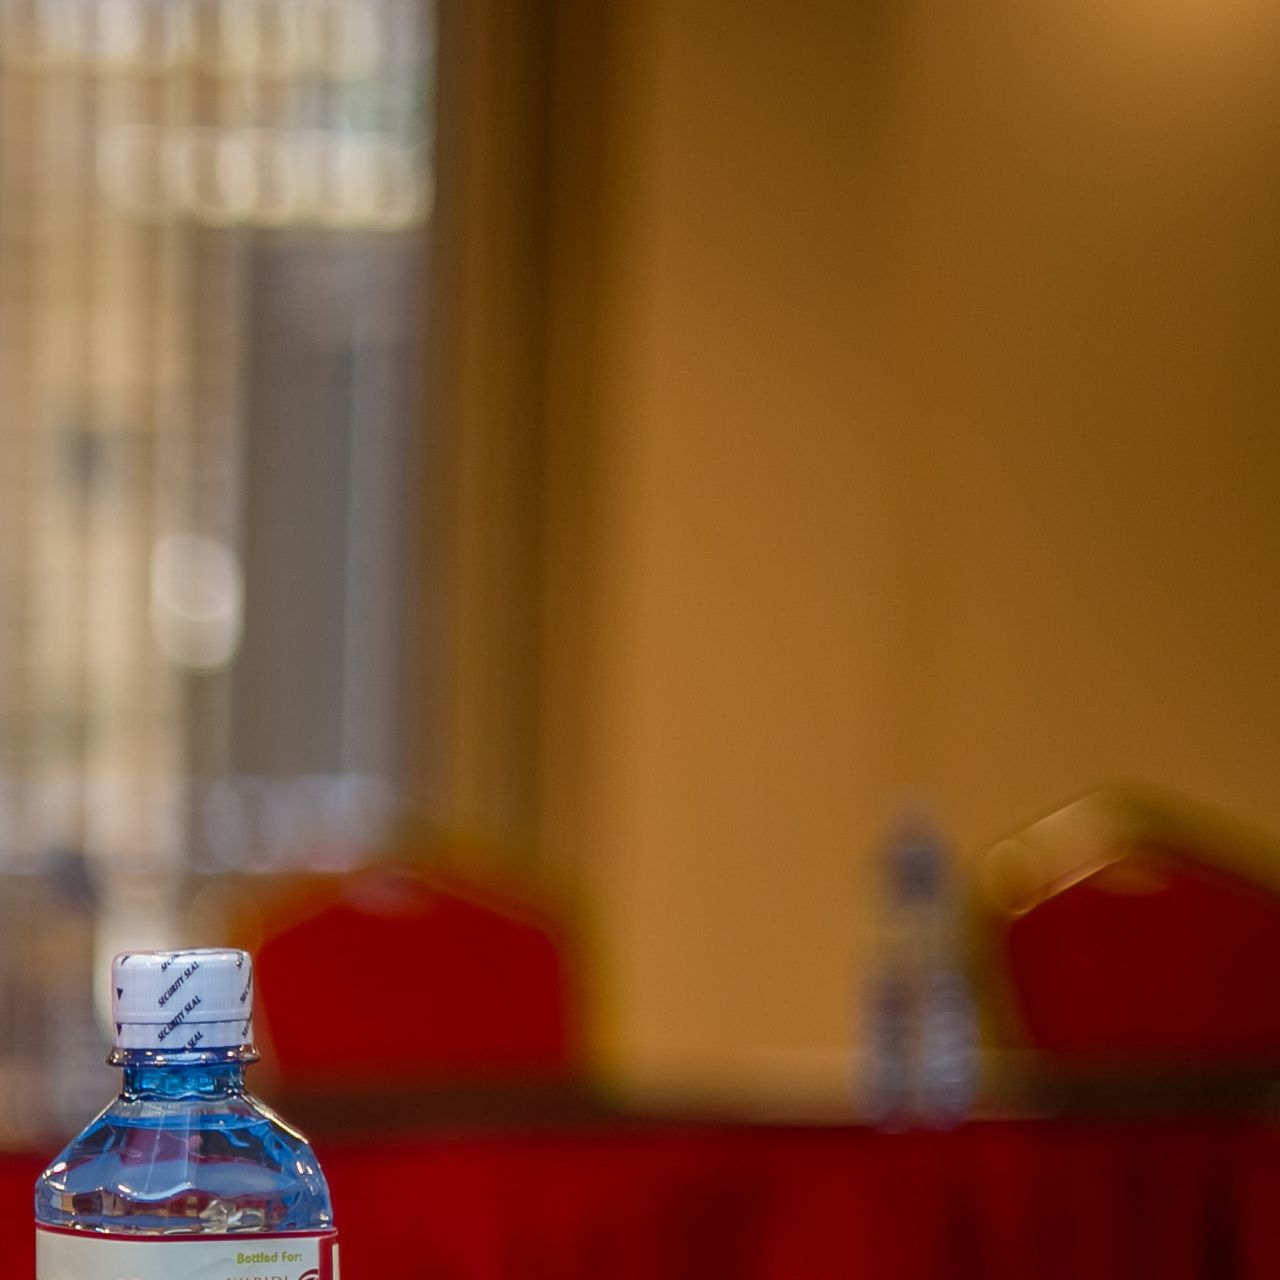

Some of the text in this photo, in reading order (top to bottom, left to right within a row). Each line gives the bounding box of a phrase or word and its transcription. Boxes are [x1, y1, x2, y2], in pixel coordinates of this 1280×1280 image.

[158, 976, 186, 1008] SECURITY
[184, 961, 200, 980] SEAL
[157, 995, 202, 1042] SECURITY SEAL
[236, 1251, 278, 1264] Bottled
